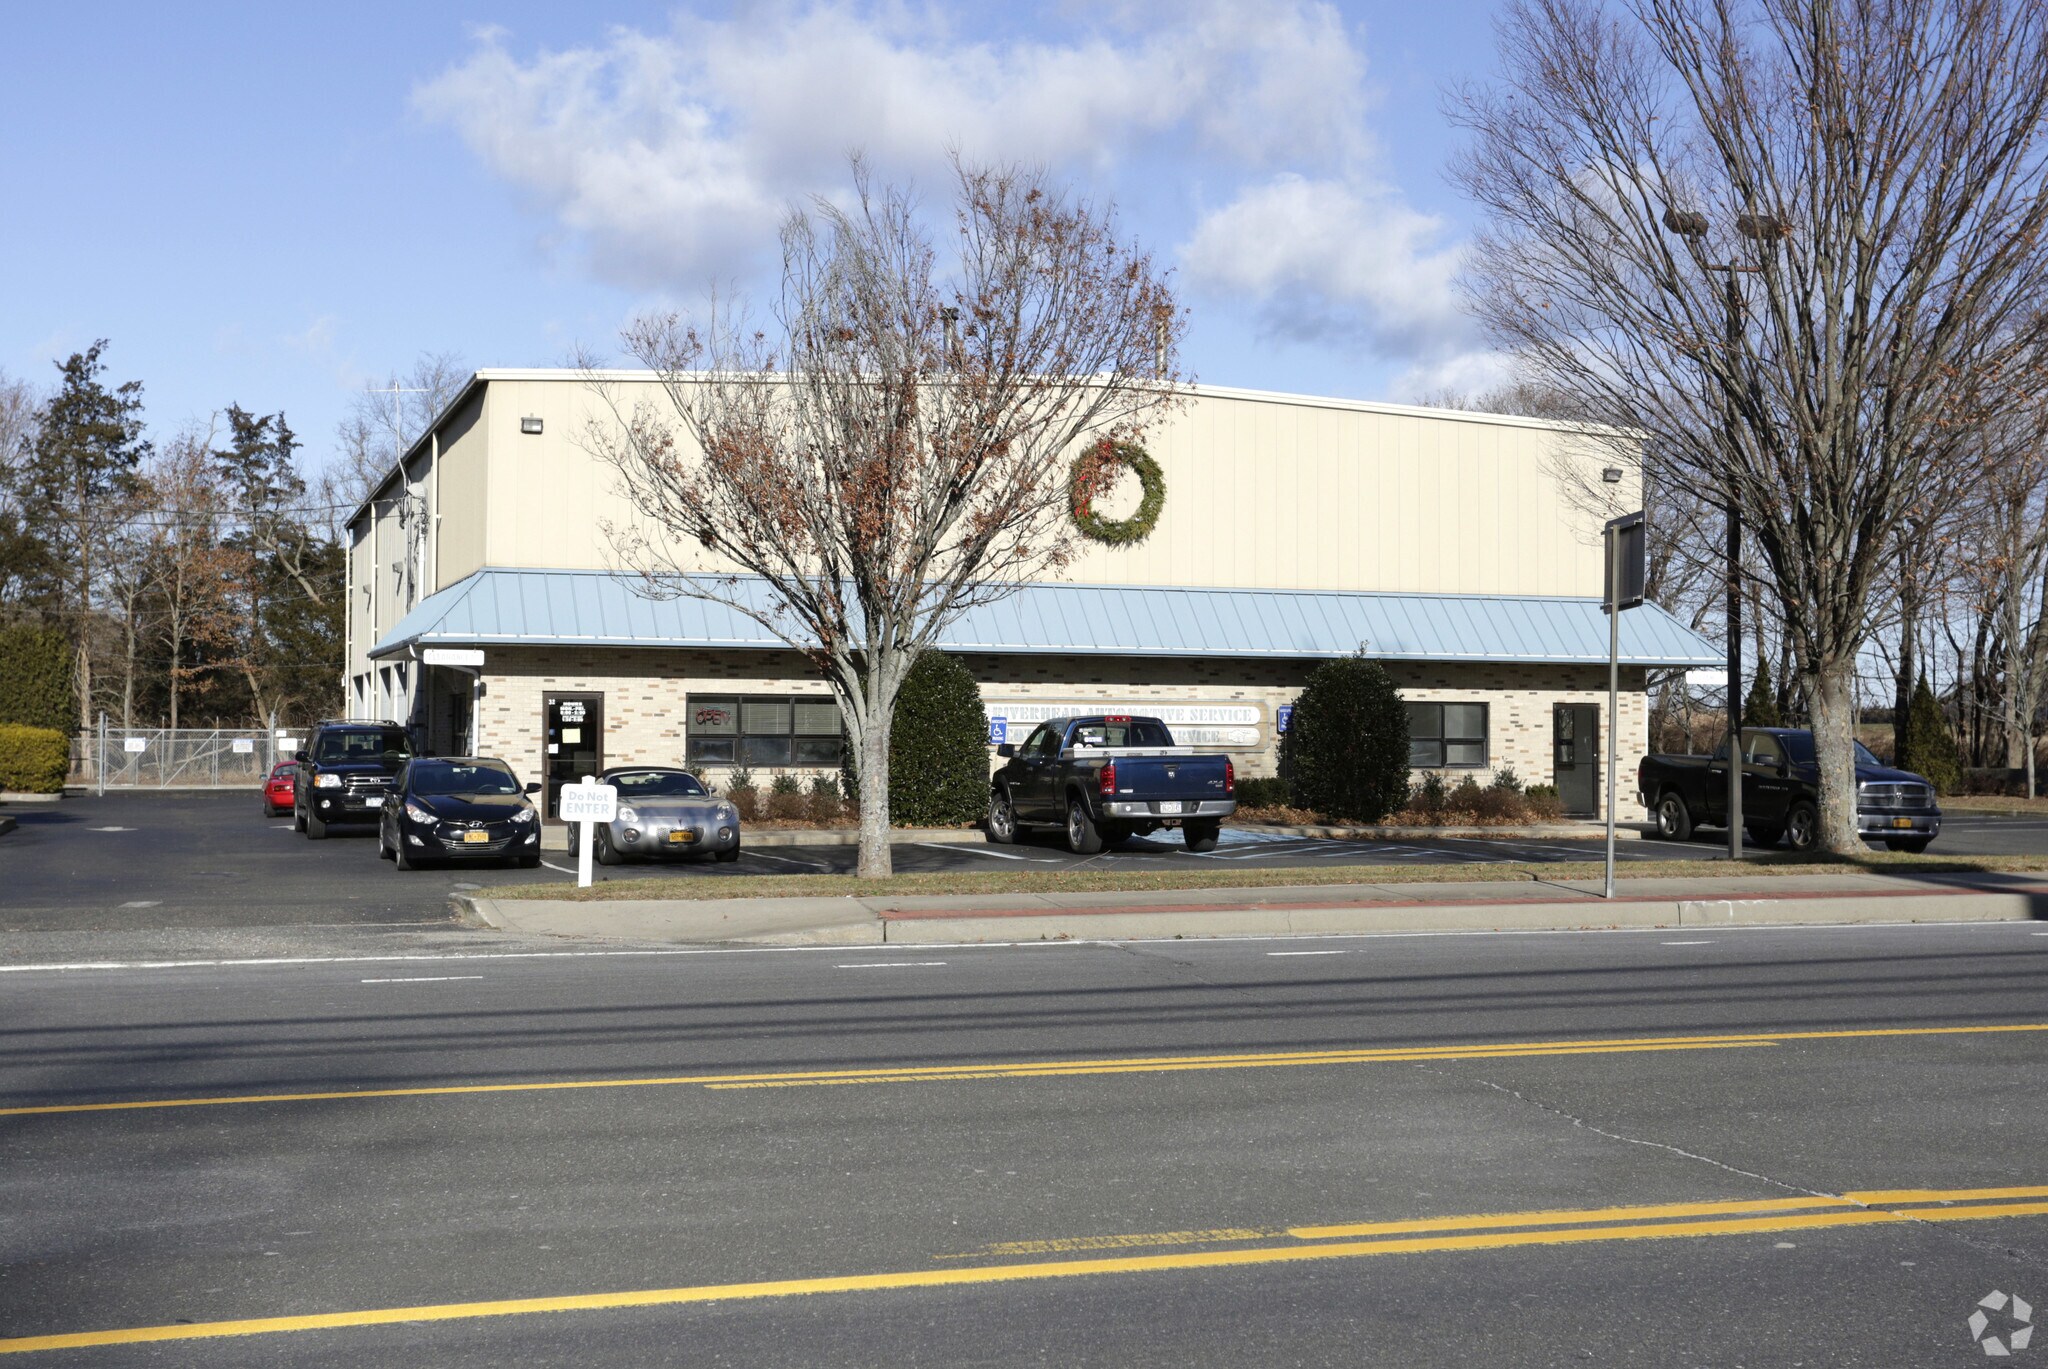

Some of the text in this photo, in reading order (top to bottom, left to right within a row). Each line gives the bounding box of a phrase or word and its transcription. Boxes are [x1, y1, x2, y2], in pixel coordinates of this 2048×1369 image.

[992, 706, 1082, 720] RIVERHEAD
[1190, 708, 1252, 722] SERVICE
[568, 791, 609, 802] Do Not
[566, 802, 610, 814] ENTER
